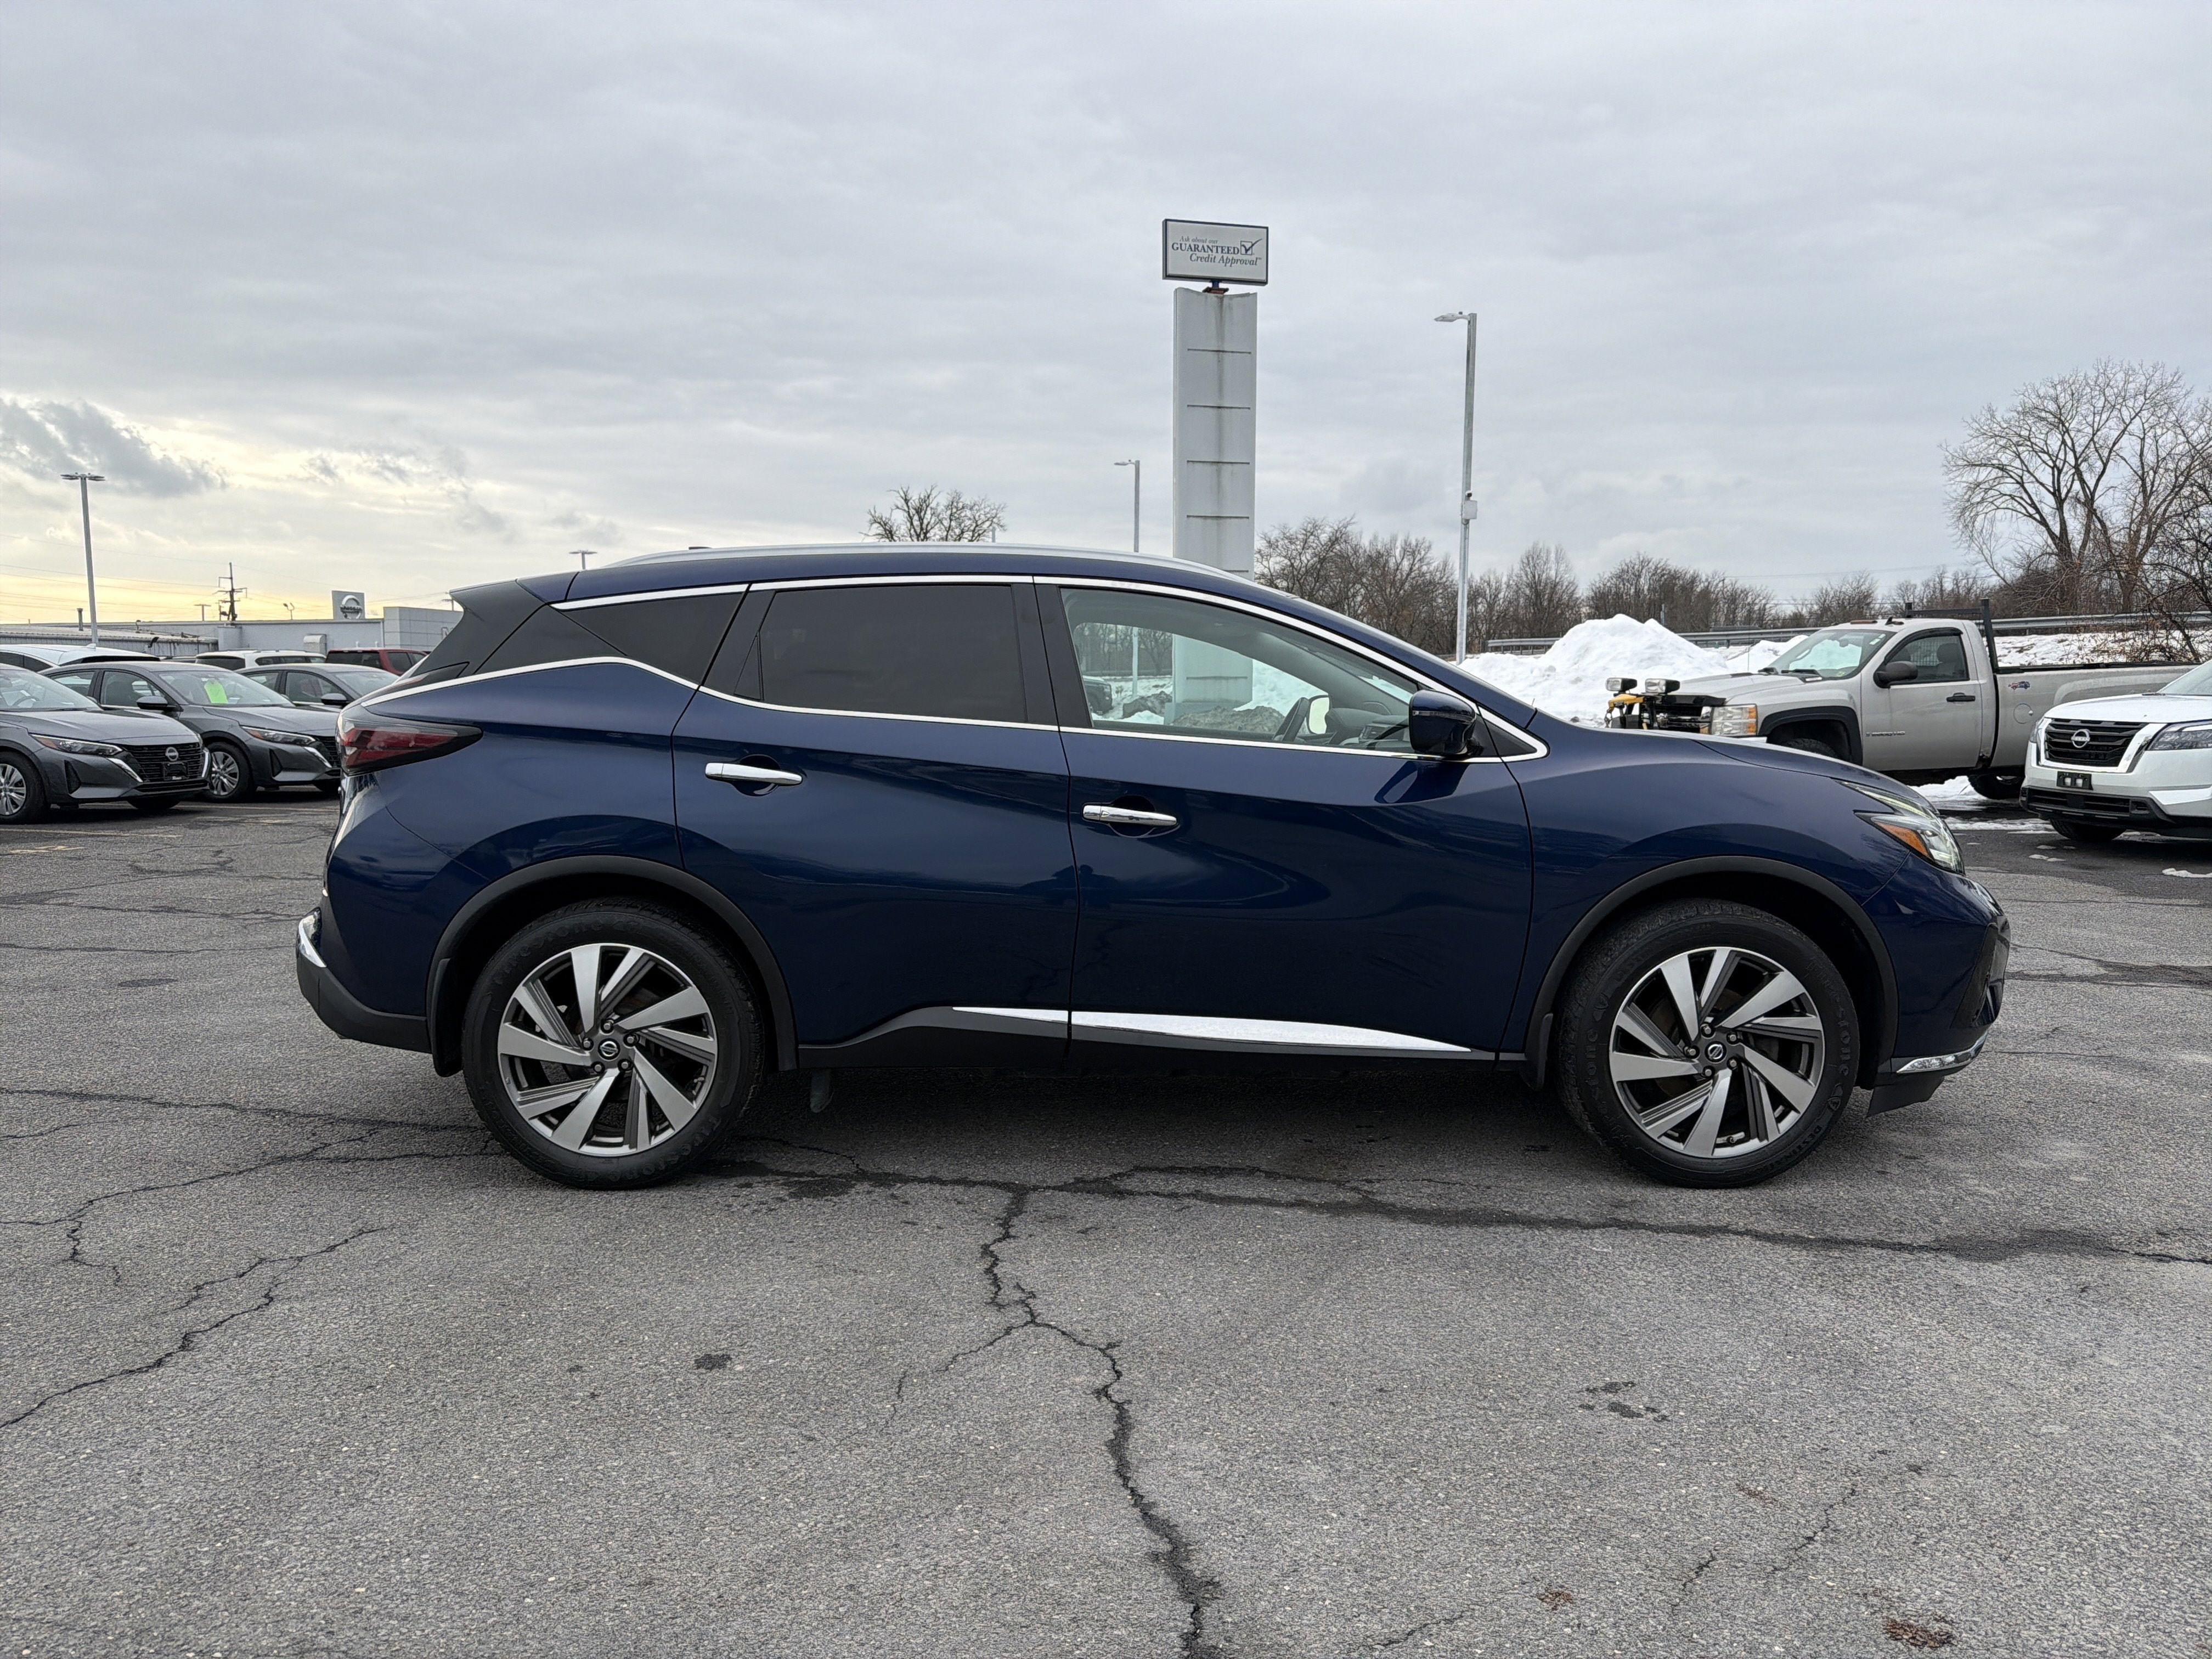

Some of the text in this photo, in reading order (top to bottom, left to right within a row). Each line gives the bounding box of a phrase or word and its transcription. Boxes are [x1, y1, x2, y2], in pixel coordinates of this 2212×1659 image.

[1171, 242, 1239, 255] GUARANTEED
[1189, 253, 1258, 267] Credit Approval
